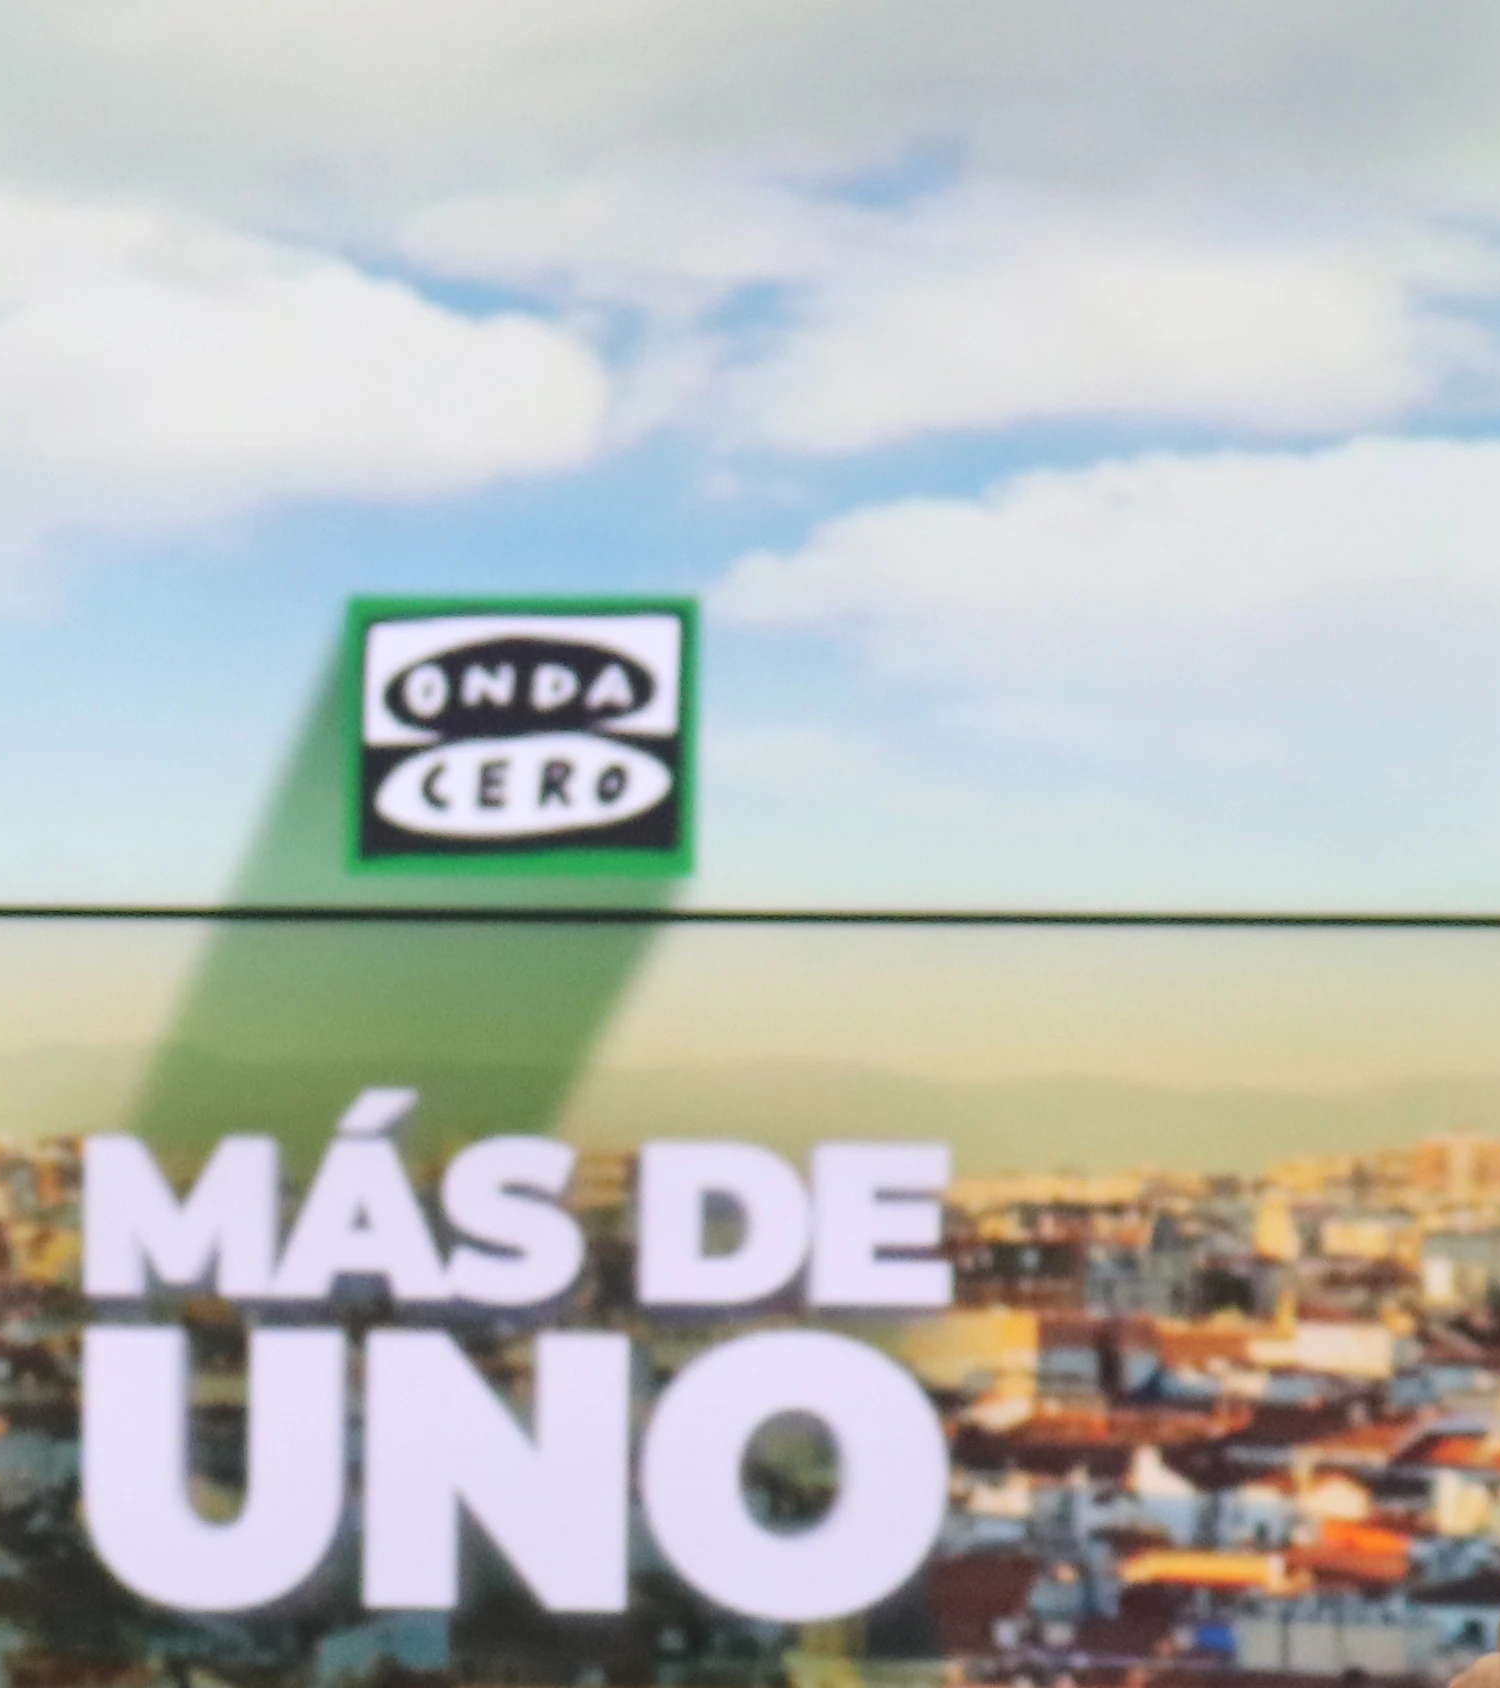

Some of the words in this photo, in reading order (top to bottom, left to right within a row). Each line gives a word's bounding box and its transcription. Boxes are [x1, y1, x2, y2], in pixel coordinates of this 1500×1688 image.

[402, 660, 635, 720] ONDA
[420, 758, 628, 812] CERO
[83, 1086, 586, 1307] MÁS
[636, 1140, 953, 1308] DE
[81, 1324, 951, 1622] UNO
